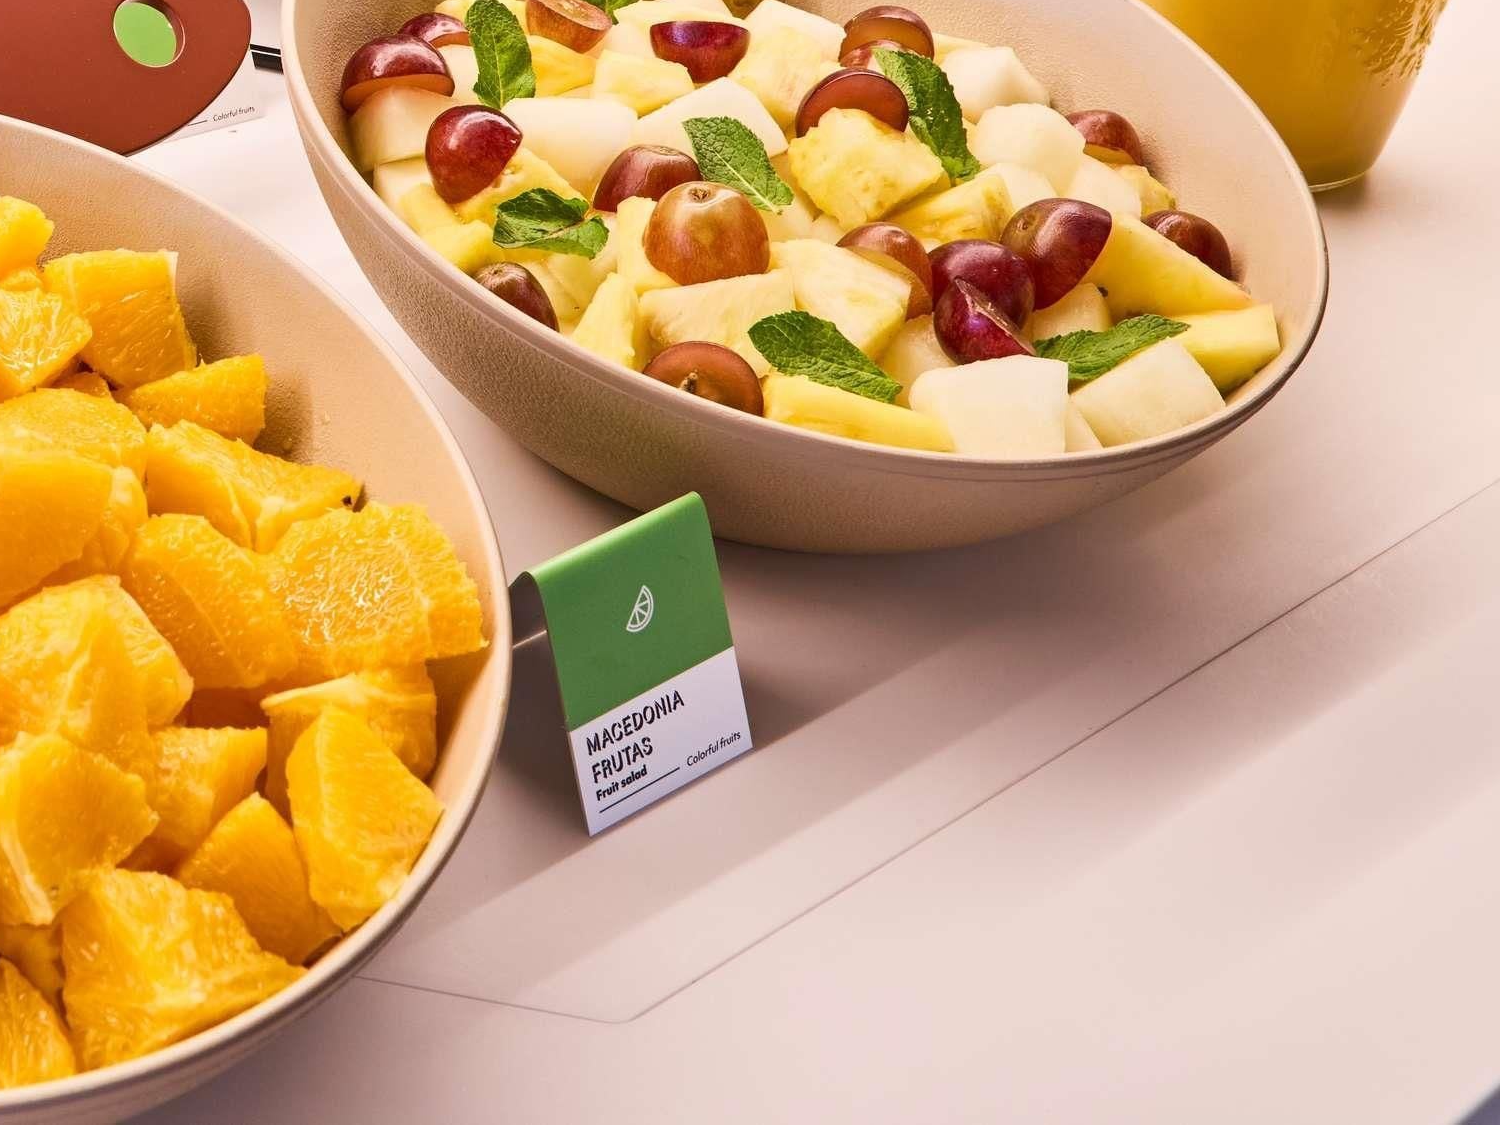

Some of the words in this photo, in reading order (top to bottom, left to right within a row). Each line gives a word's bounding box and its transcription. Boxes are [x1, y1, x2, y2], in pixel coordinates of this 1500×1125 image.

[212, 108, 238, 122] Colorful
[238, 106, 255, 115] fruits
[586, 690, 685, 756] MACEDONIA
[591, 736, 653, 784] FRUTAS
[686, 740, 719, 766] Colorful
[720, 731, 741, 749] fruits
[596, 781, 619, 801] Fruit
[621, 764, 648, 788] salad
